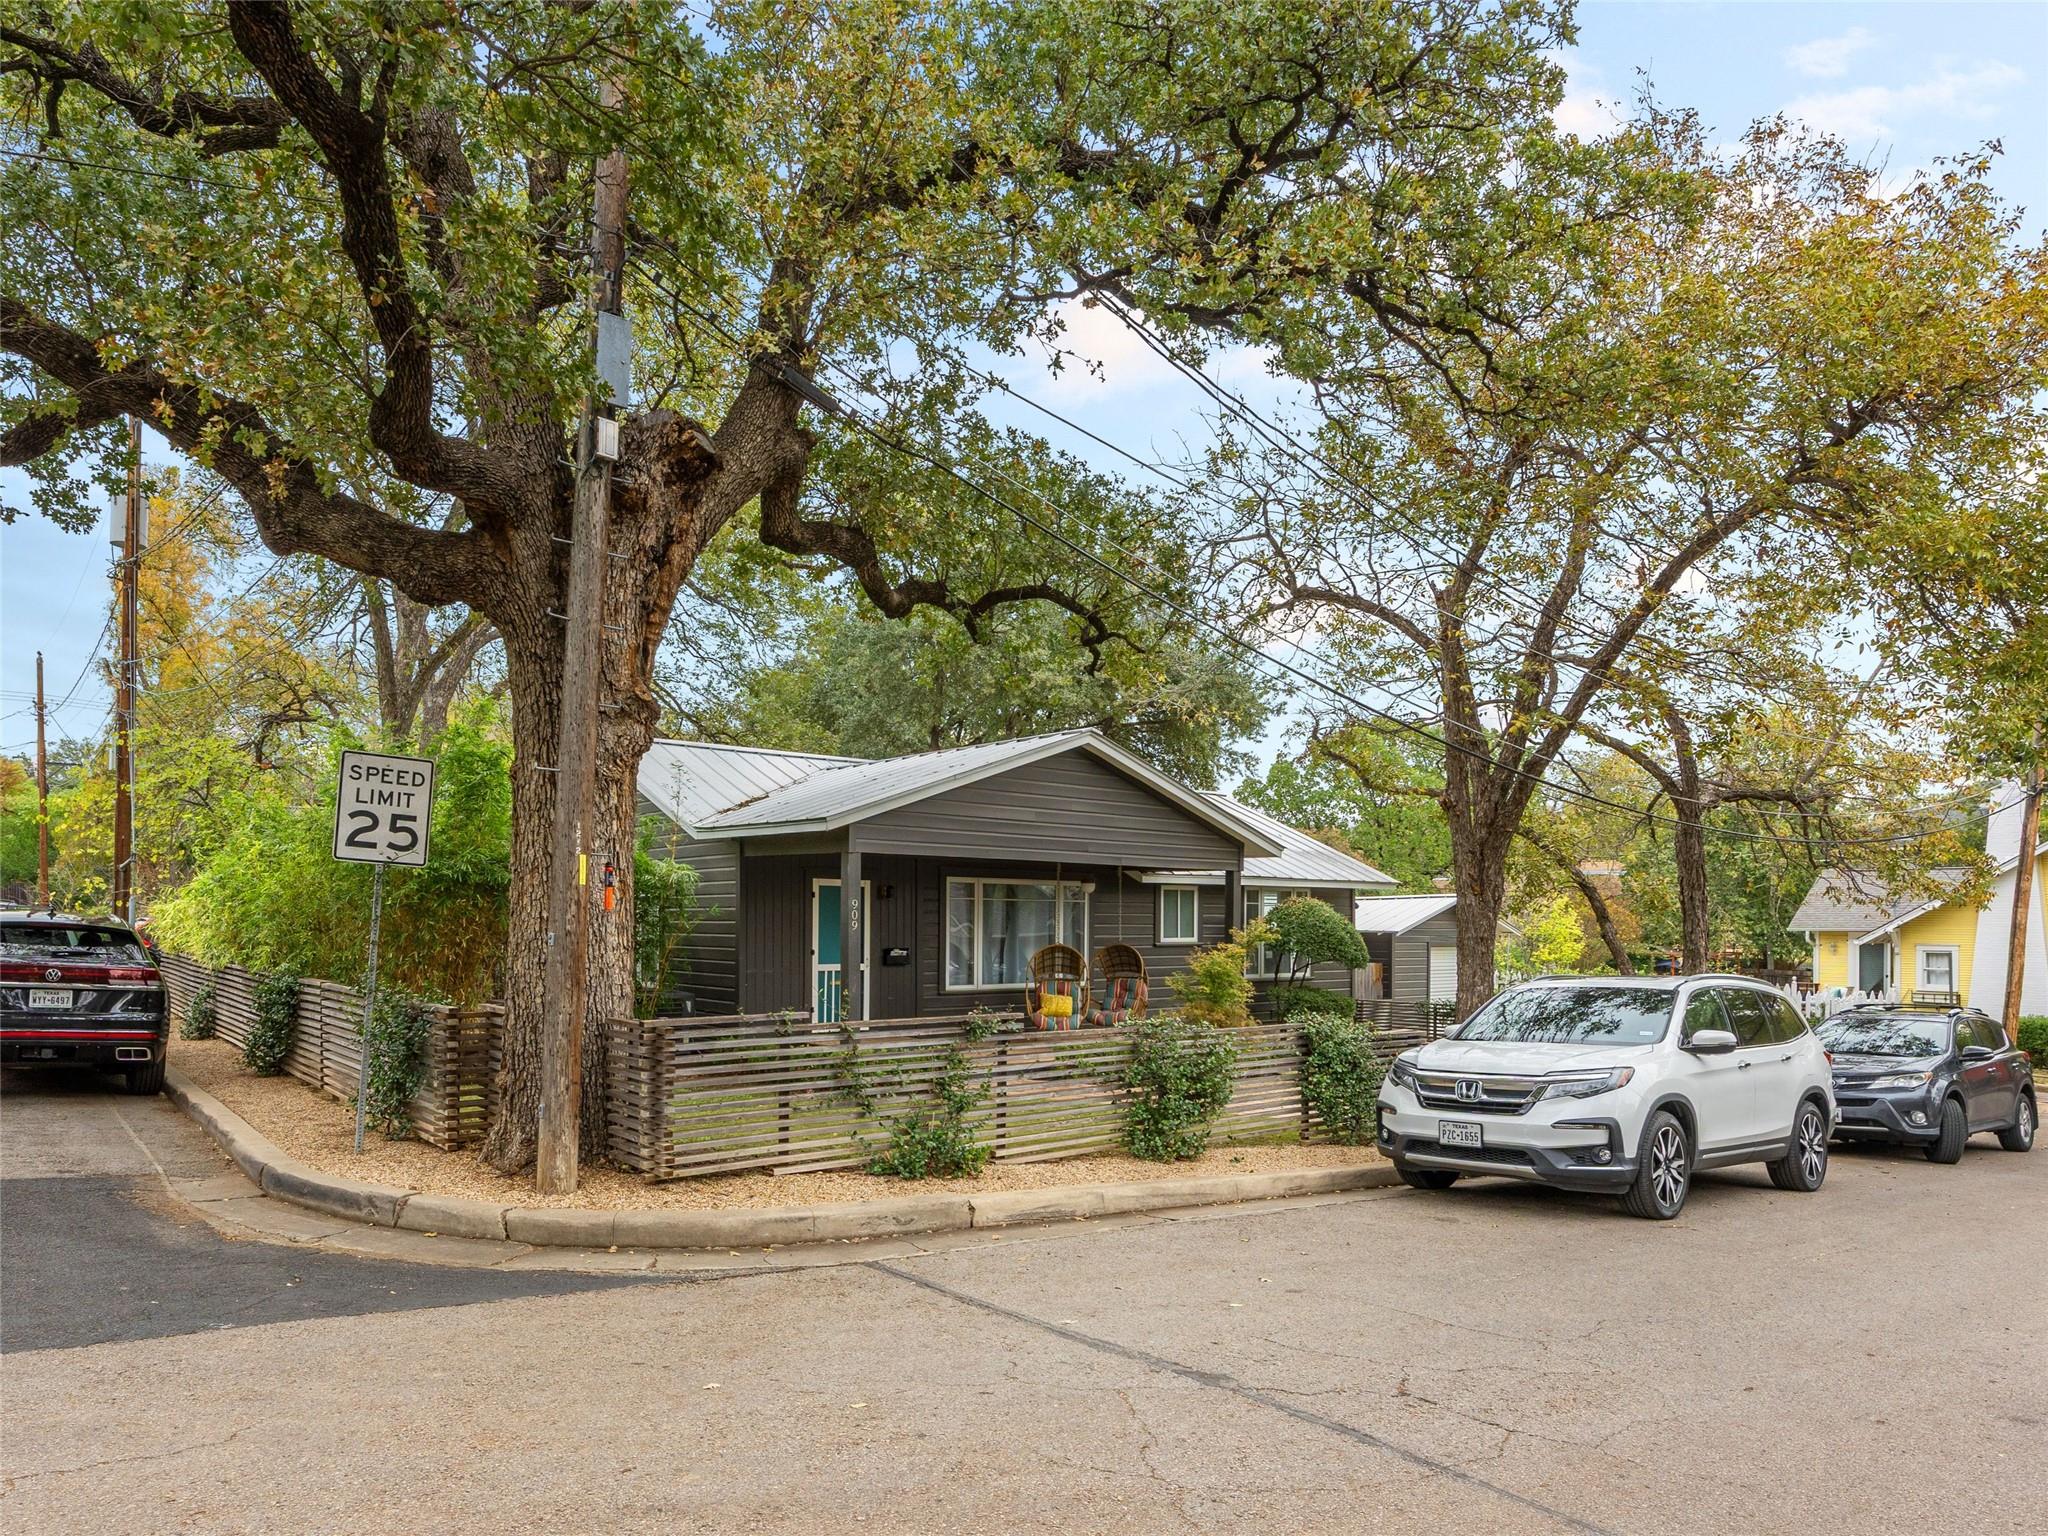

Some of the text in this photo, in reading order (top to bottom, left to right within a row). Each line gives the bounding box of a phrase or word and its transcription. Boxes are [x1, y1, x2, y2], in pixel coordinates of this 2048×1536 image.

[349, 764, 425, 787] SPEED
[355, 787, 416, 808] LIMIT
[344, 809, 419, 853] 25
[851, 898, 859, 931] 909
[1442, 1128, 1479, 1143] PZC-1655
